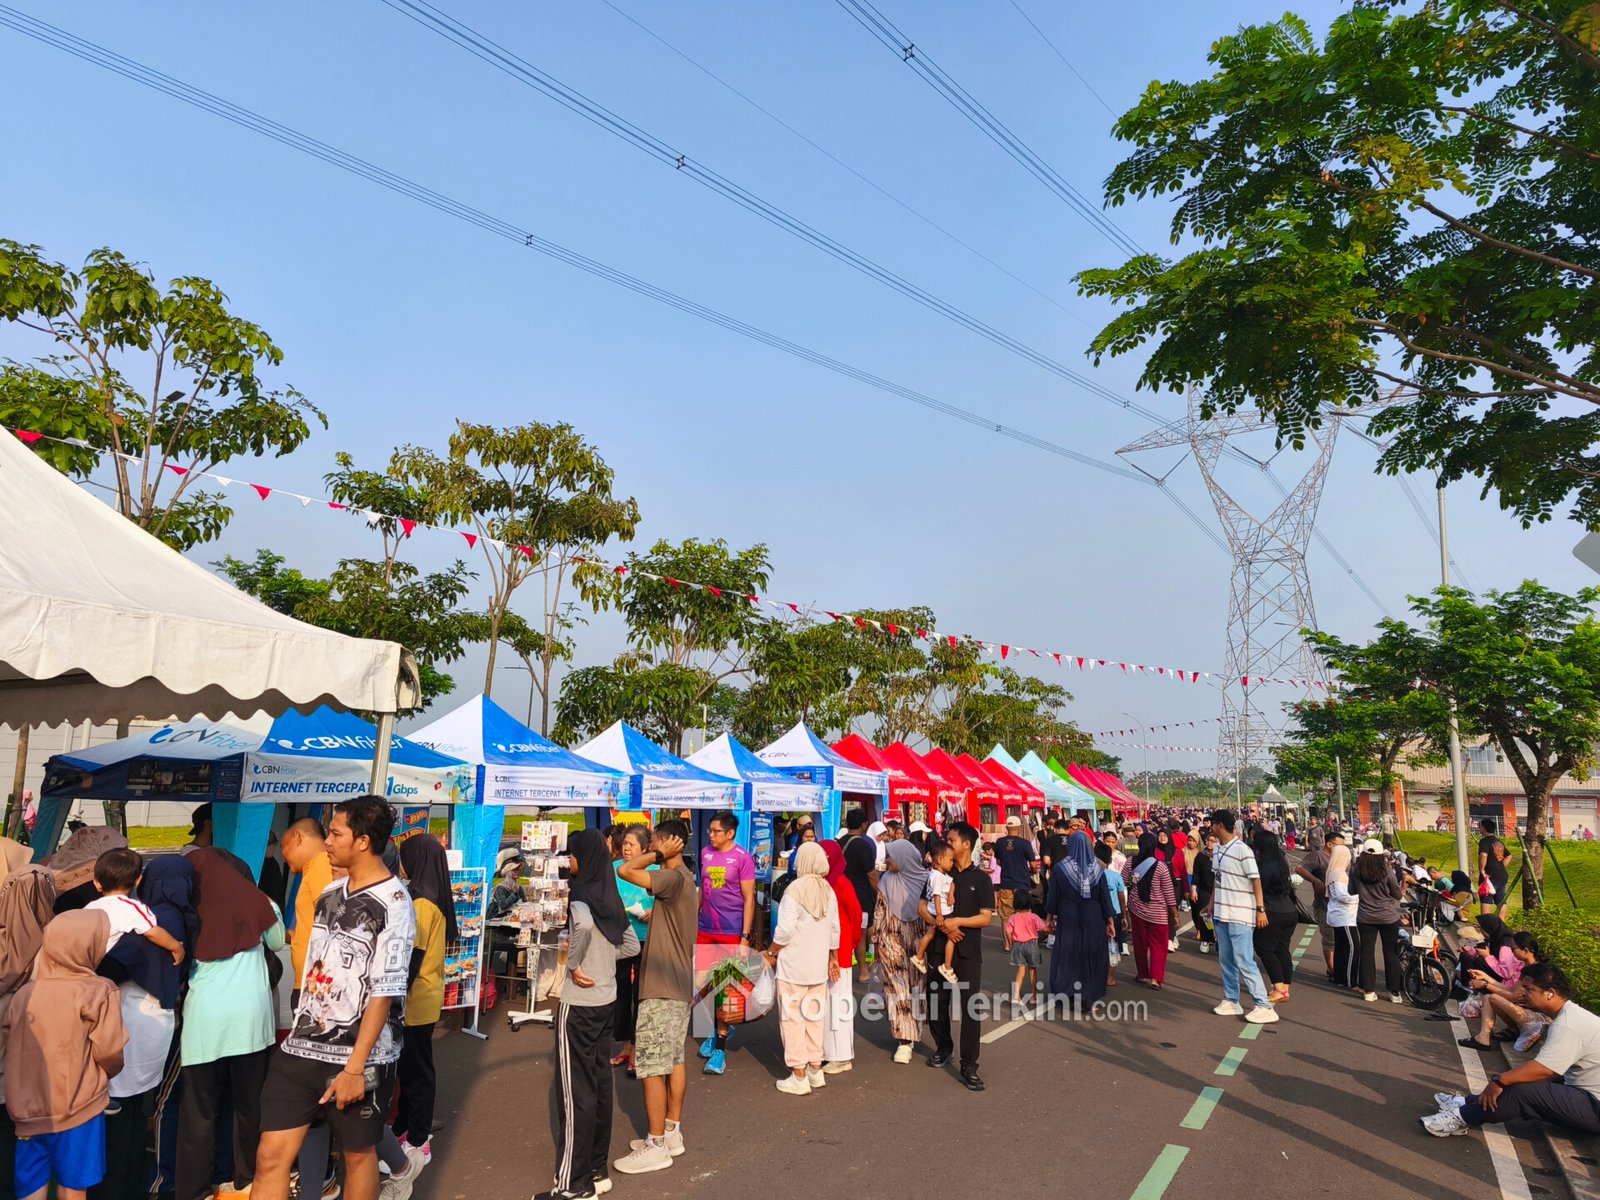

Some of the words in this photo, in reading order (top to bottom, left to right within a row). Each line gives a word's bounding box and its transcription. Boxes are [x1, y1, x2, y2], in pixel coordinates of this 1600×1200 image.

[261, 764, 298, 776] CBNfiber
[250, 781, 312, 794] INTERNET
[494, 788, 528, 798] INTERNET
[529, 788, 562, 798] TERCEPAT
